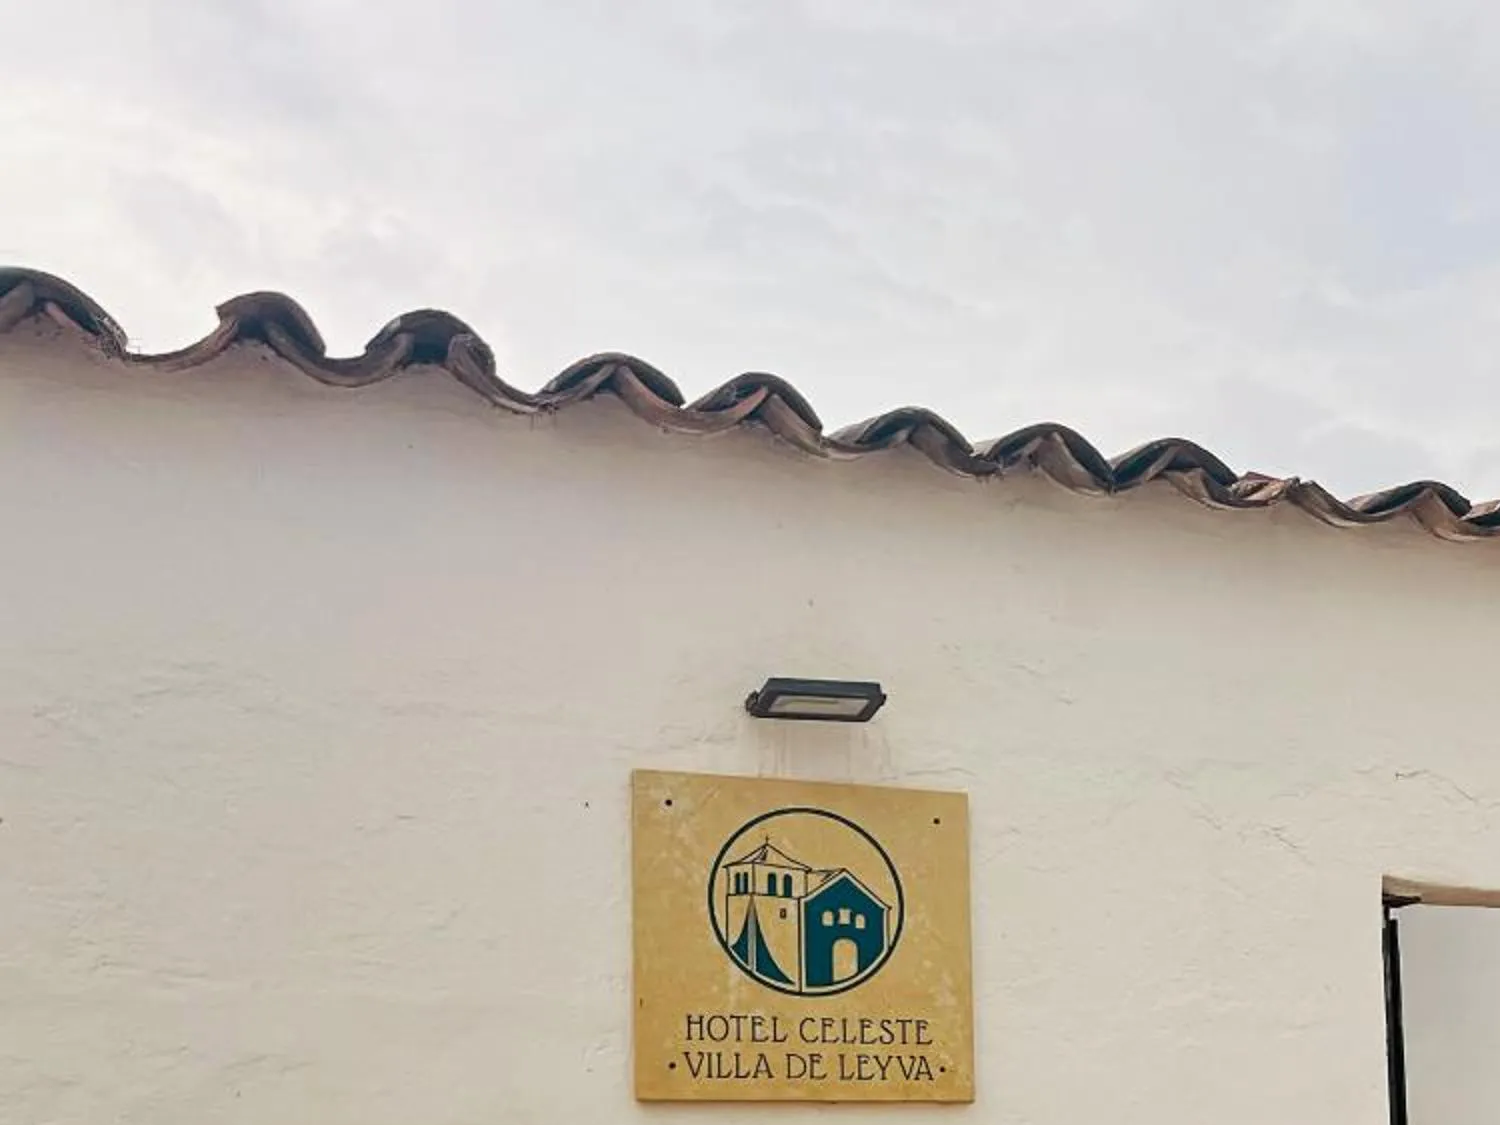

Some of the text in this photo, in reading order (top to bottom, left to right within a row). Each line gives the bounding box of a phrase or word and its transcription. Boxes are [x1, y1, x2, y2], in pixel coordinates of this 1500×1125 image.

[685, 1014, 933, 1045] HOTEL CELESTE
[683, 1051, 935, 1081] VILLA DE LEYVA
